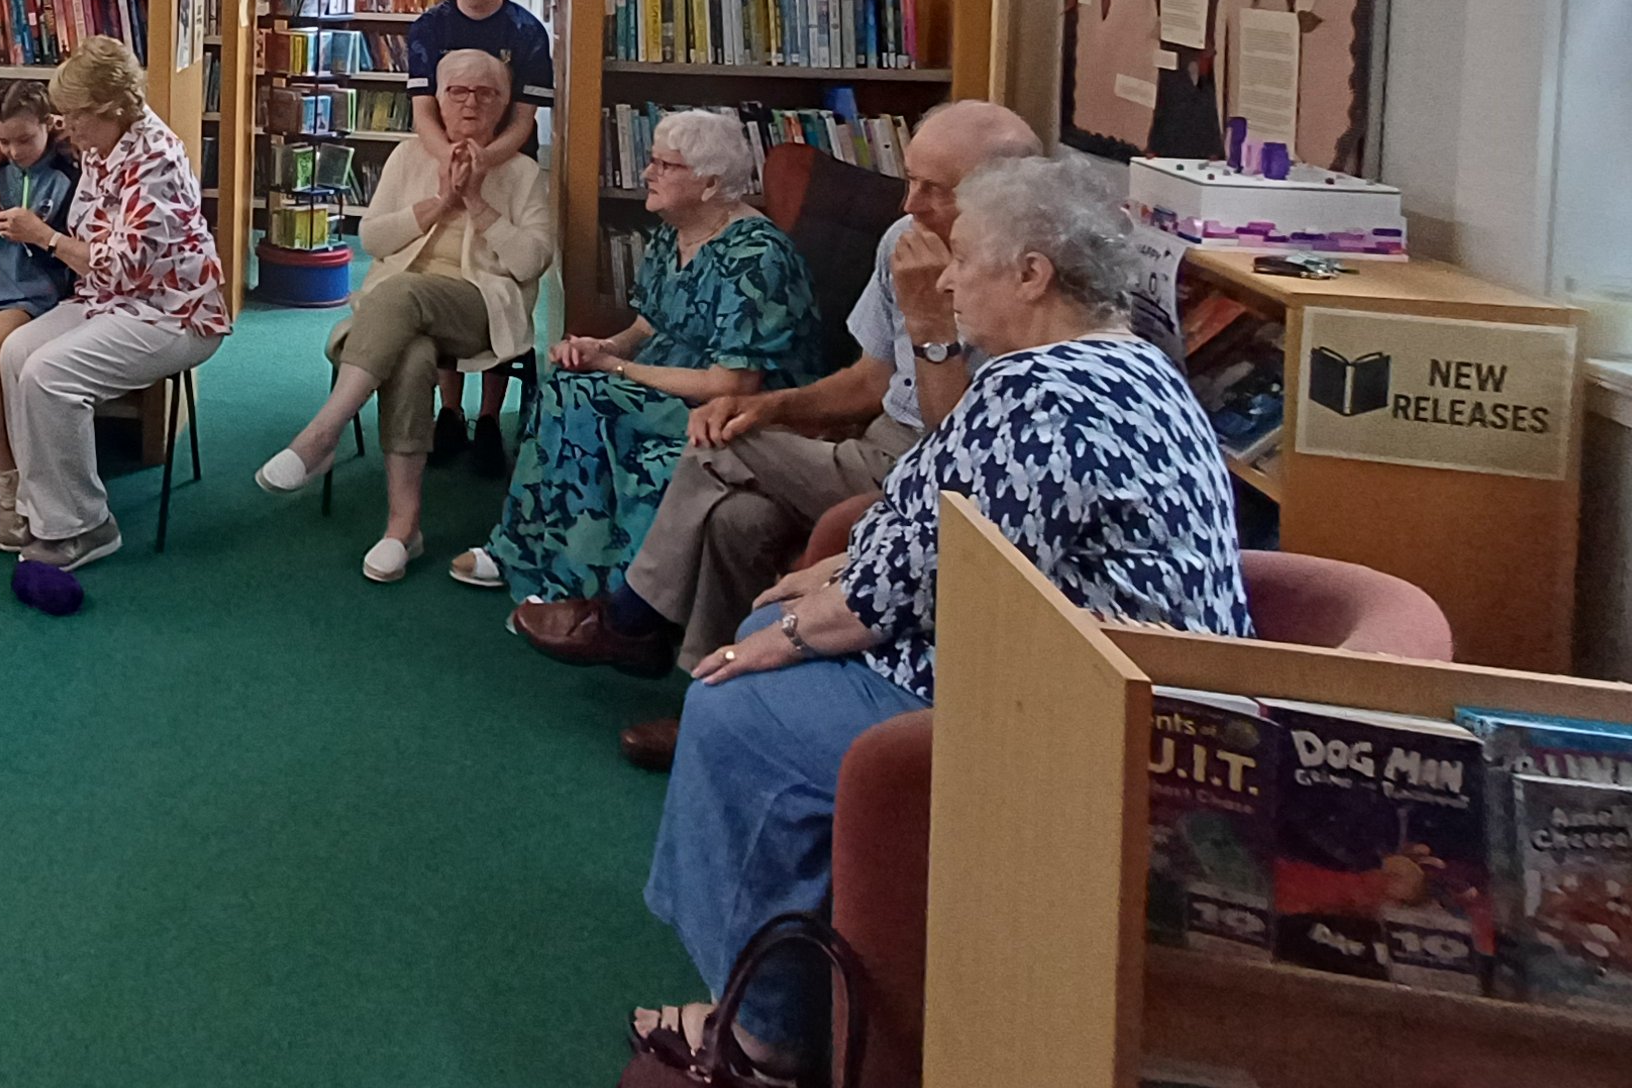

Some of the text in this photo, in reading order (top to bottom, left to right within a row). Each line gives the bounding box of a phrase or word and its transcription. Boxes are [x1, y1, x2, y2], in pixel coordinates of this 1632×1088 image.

[1428, 359, 1508, 393] NEW
[1392, 393, 1551, 434] RELEASES
[1291, 730, 1377, 779] DOG
[1383, 746, 1464, 794] MAN
